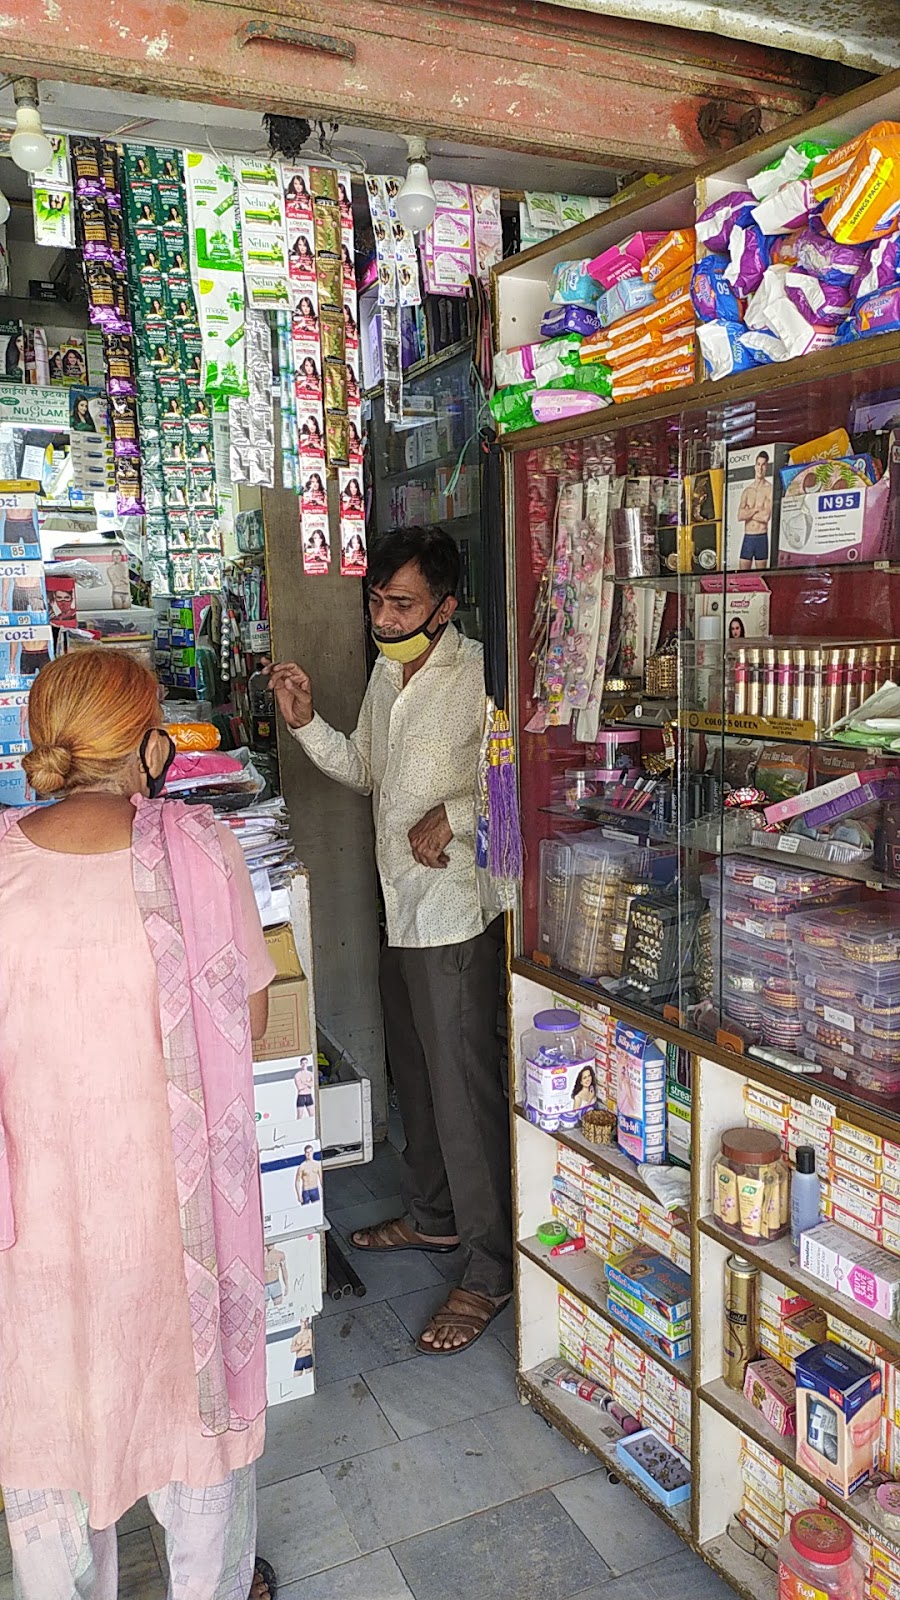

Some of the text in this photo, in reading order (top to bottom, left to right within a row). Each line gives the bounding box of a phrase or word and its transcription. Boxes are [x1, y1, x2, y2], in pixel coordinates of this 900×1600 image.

[849, 181, 883, 226] SAVINGS PACK
[716, 281, 731, 295] 50
[873, 308, 884, 318] XL
[583, 314, 602, 328] Stay
[729, 454, 751, 464] OCKEY
[823, 495, 854, 509] N95
[67, 522, 91, 530] VEGA
[12, 547, 25, 556] 85
[5, 627, 34, 641] cozi
[734, 720, 758, 730] QUEEN
[670, 1085, 691, 1101] strea
[814, 1098, 833, 1114] PINK
